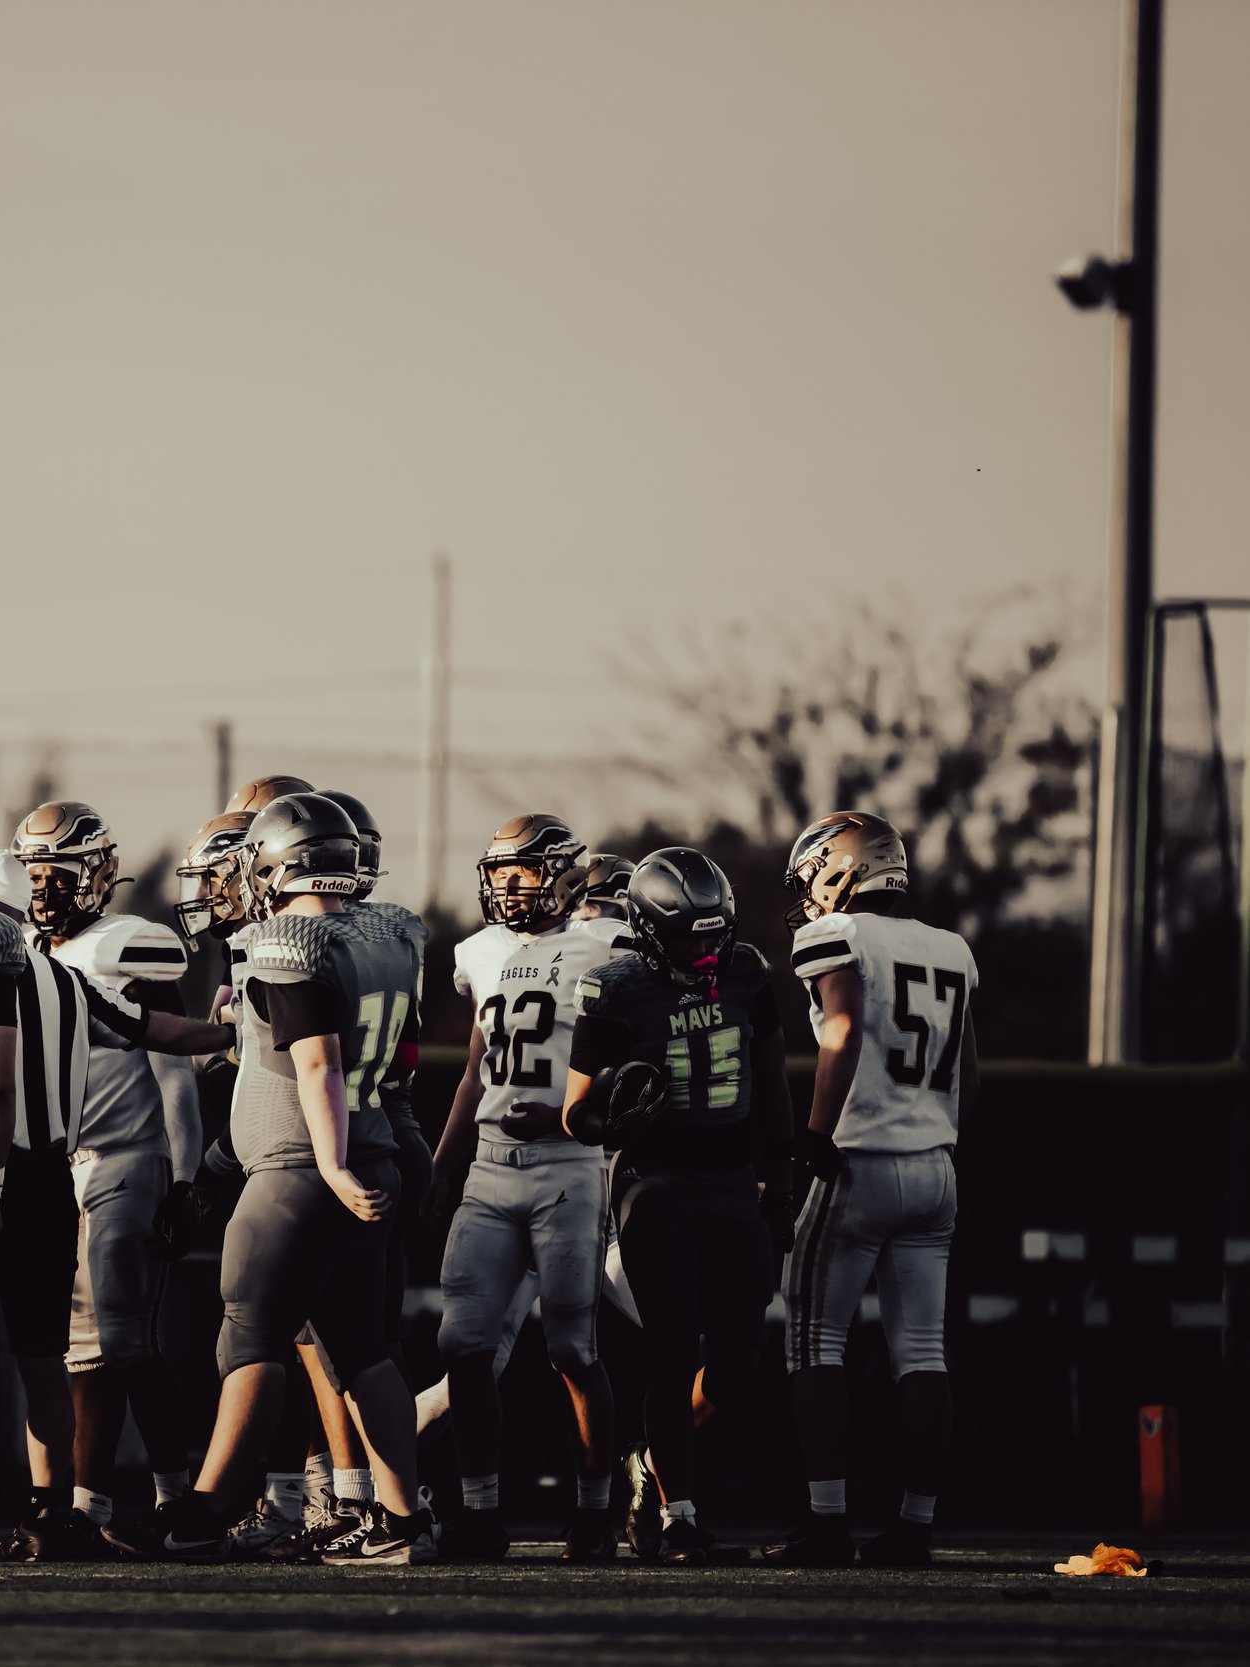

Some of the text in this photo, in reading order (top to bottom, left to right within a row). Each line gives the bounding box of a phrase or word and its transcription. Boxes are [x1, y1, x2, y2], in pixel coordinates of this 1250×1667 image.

[311, 879, 355, 892] Riddell
[698, 919, 722, 928] Riddell
[500, 967, 539, 981] EAGLES
[669, 1002, 723, 1036] MAVS
[885, 961, 965, 1093] 57
[479, 990, 556, 1087] 32
[665, 1026, 741, 1110] 15
